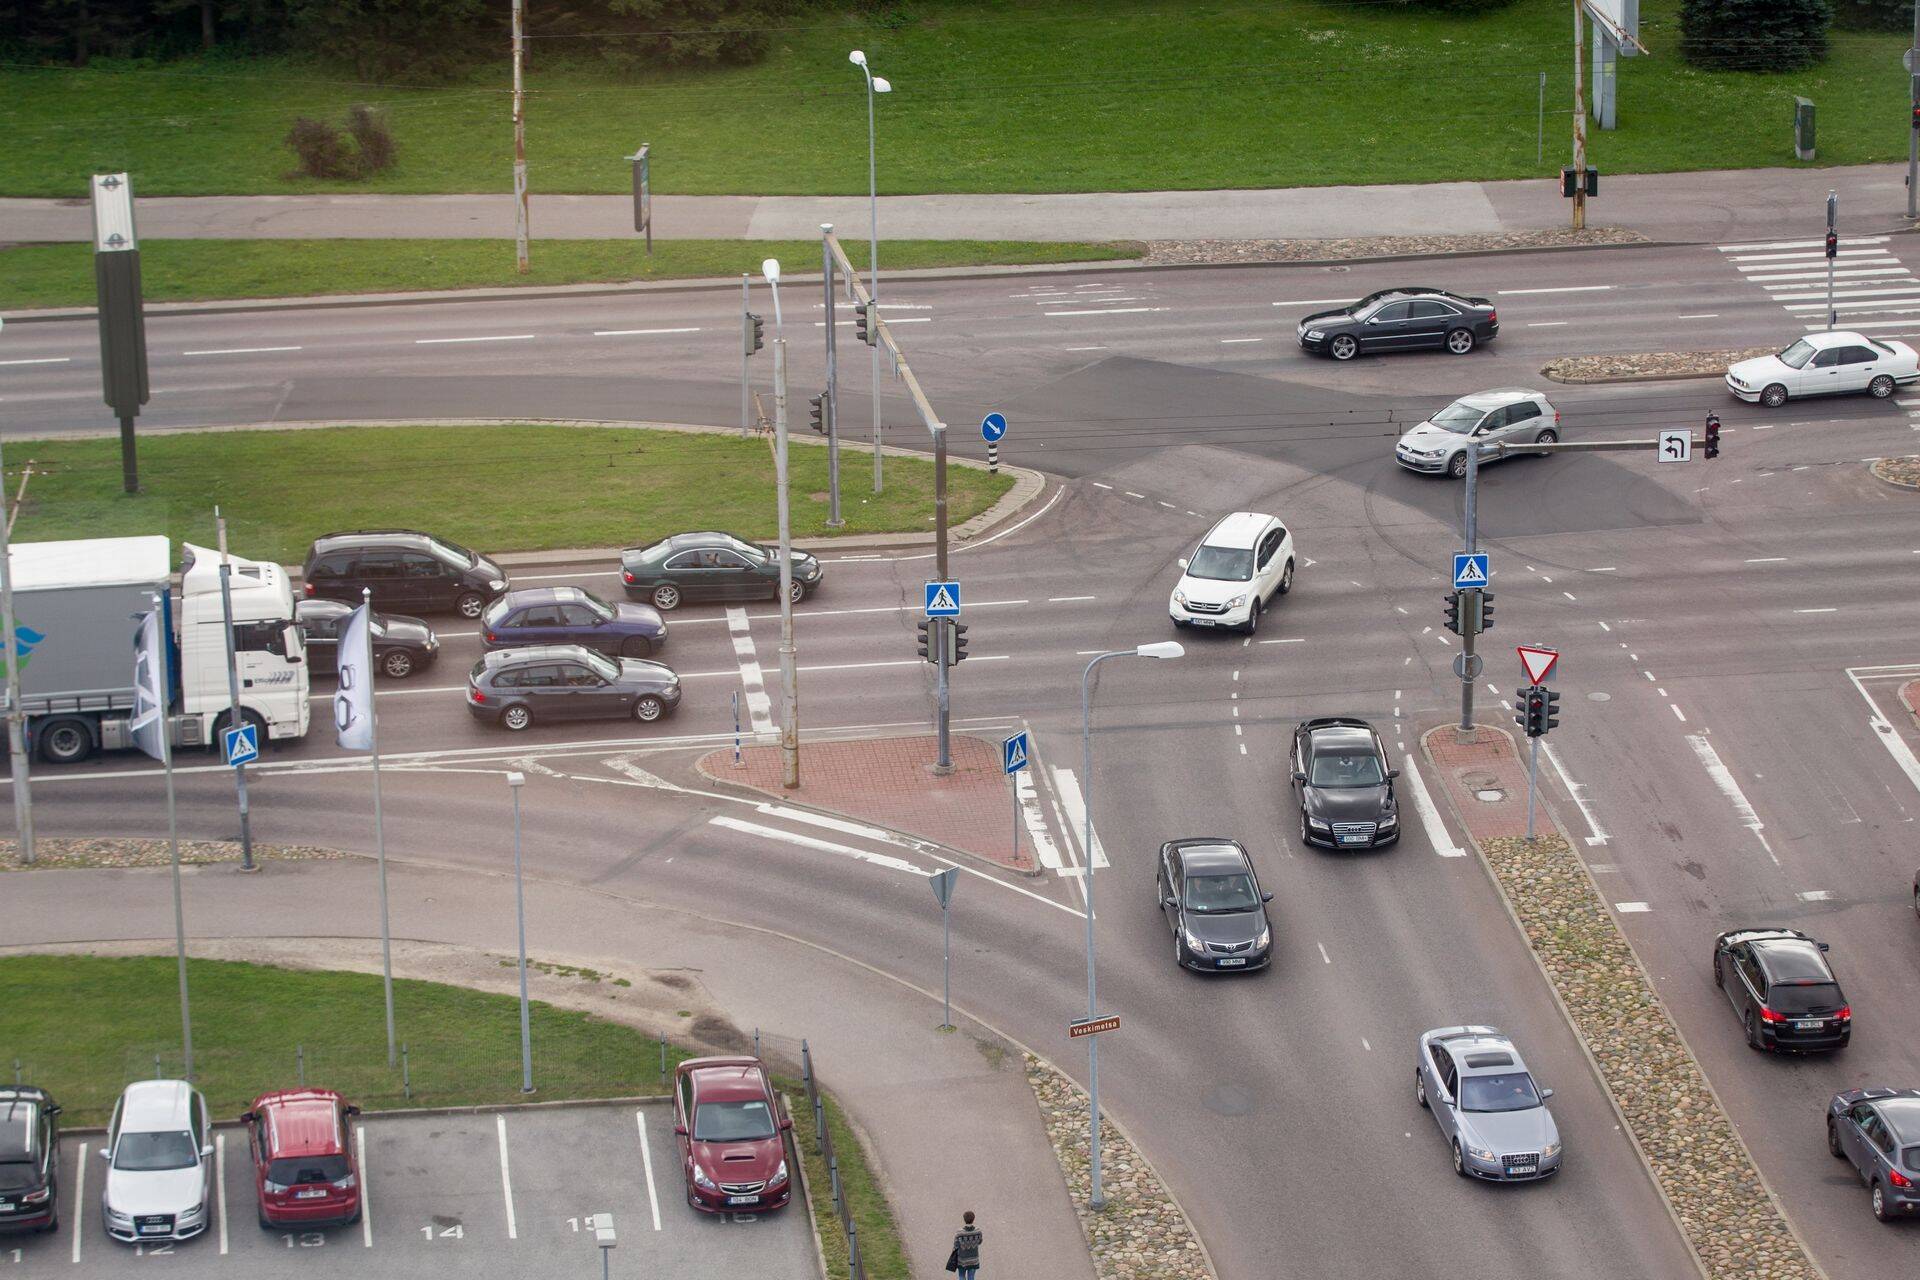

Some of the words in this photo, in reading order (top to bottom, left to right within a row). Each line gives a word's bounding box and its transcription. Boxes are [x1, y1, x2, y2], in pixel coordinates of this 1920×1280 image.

[1072, 1021, 1118, 1036] Veskimetsa
[420, 1224, 464, 1240] 14
[281, 1232, 325, 1248] 13
[133, 1242, 175, 1256] 12
